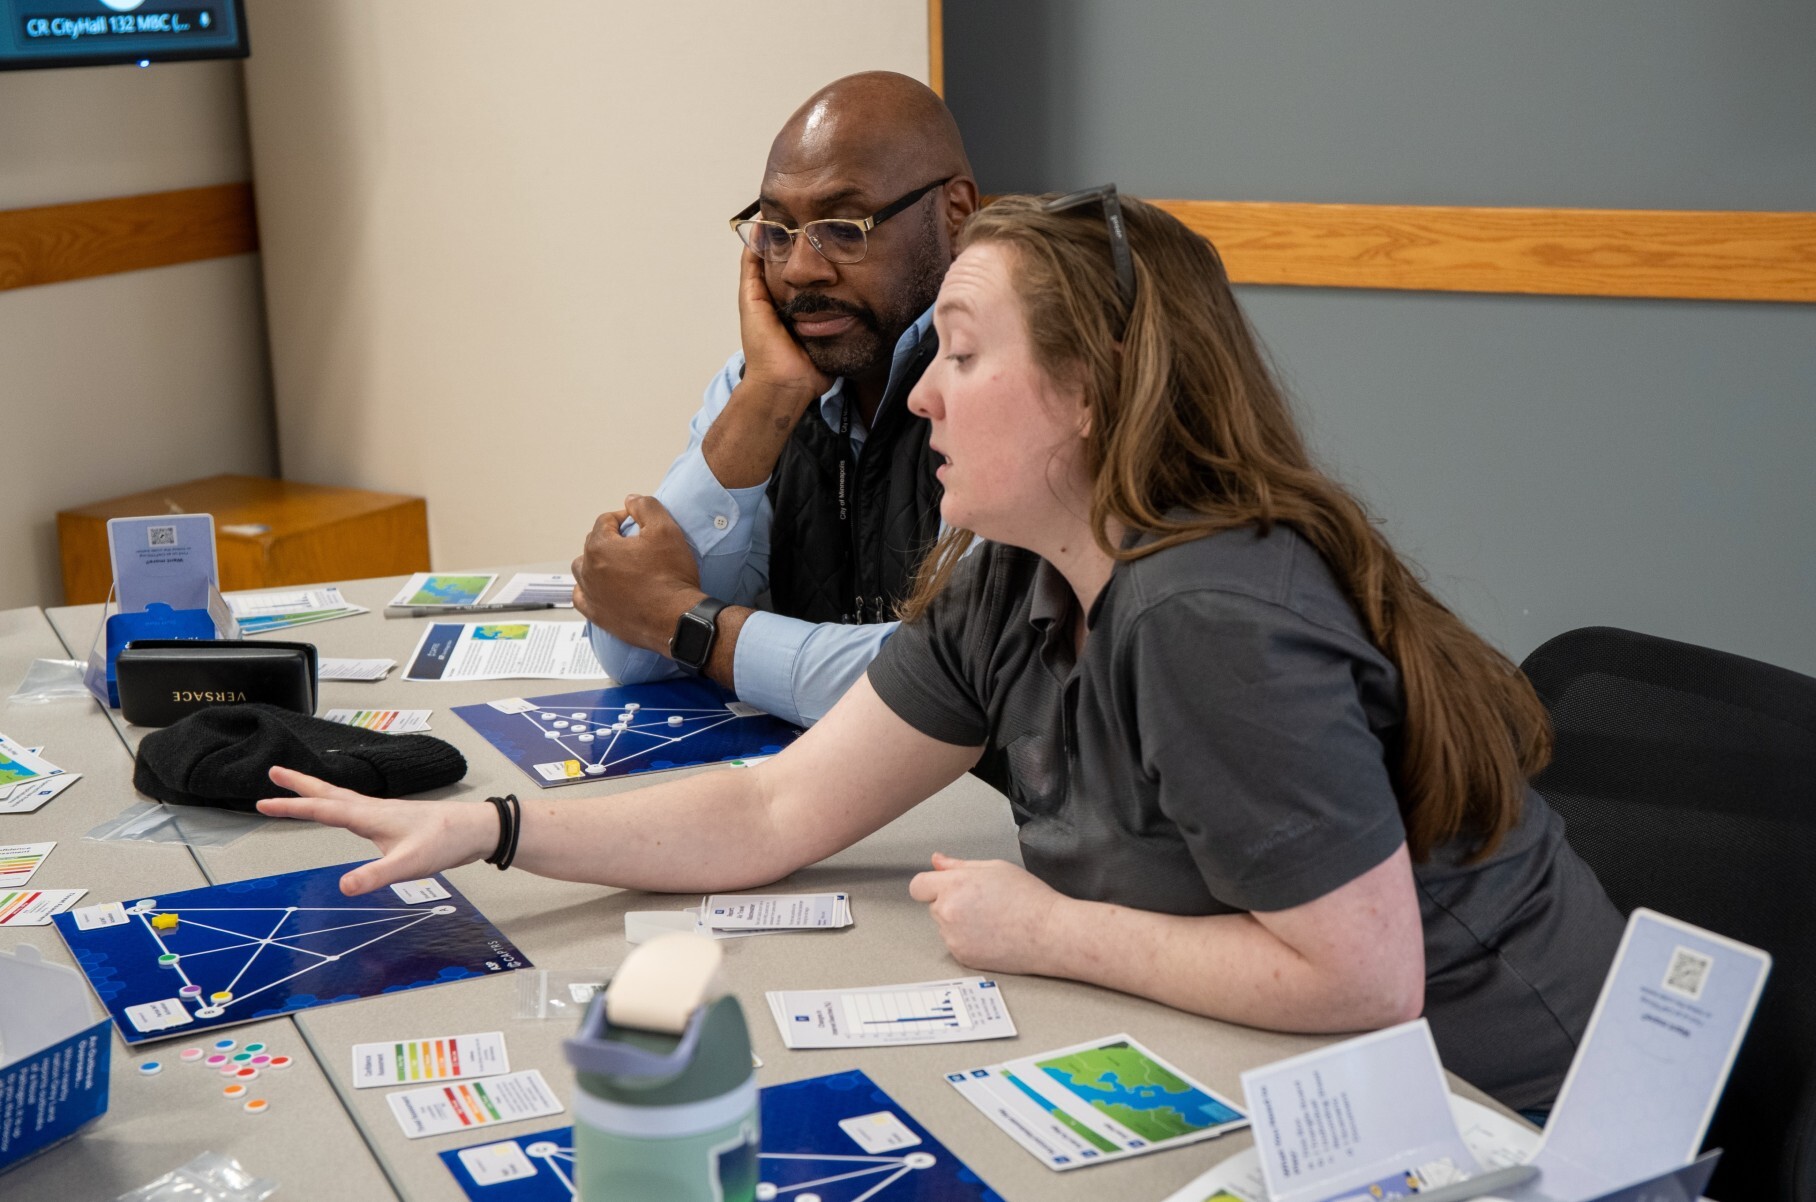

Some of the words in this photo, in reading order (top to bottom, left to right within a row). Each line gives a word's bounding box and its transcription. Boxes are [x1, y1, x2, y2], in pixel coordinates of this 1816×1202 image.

[27, 19, 50, 37] CR
[51, 17, 107, 39] CityHall
[109, 17, 136, 33] 132
[137, 15, 171, 33] MBC
[838, 459, 846, 499] Minneapolis
[839, 498, 845, 506] of
[172, 691, 247, 702] VERSACE
[488, 940, 514, 962] CAPTRS
[84, 1047, 96, 1090] Outbreak
